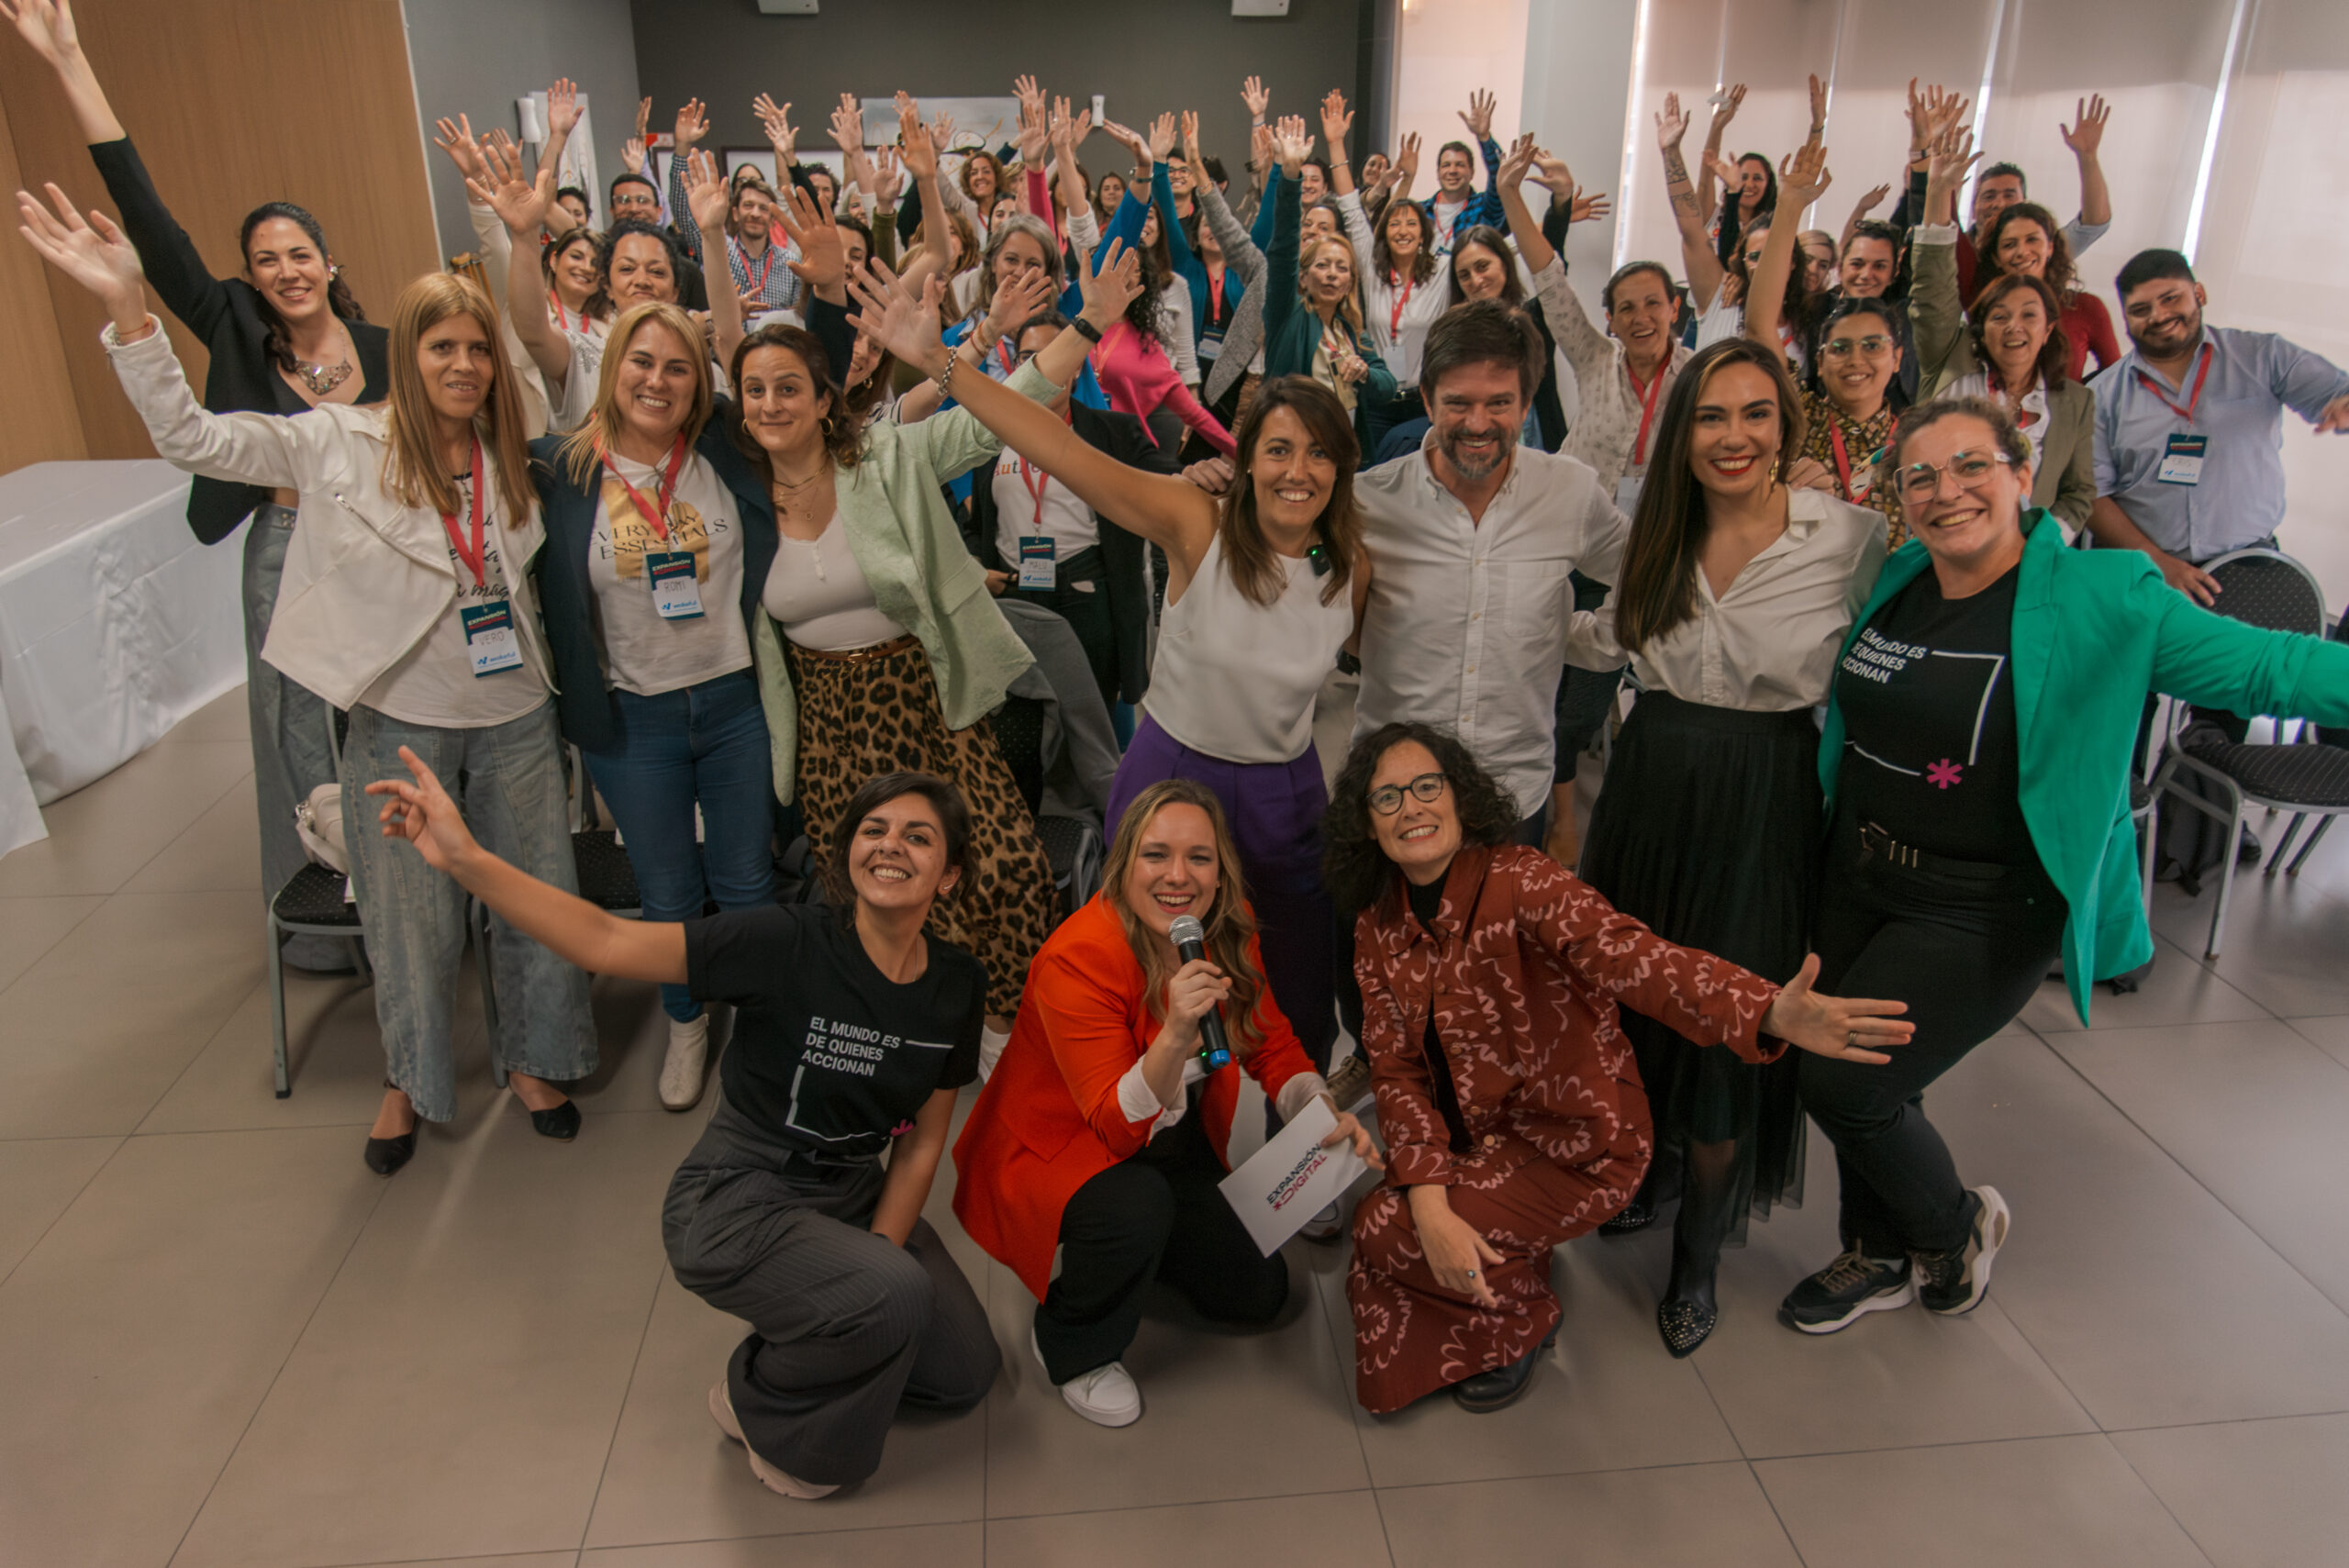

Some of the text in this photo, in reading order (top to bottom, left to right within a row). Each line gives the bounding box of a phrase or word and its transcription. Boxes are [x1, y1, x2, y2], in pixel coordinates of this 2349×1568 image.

[478, 630, 505, 646] VERO
[1906, 646, 1927, 659] ES
[1842, 655, 1890, 684] CCIONAN
[1856, 646, 1908, 671] QUIENES
[810, 1016, 901, 1049] EL MUNDO ES
[806, 1033, 885, 1062] DE QUIENES
[801, 1049, 875, 1077] ACCIONAN
[1266, 1142, 1321, 1205] EXPANSIÓN
[1280, 1153, 1328, 1206] DIGITAL
